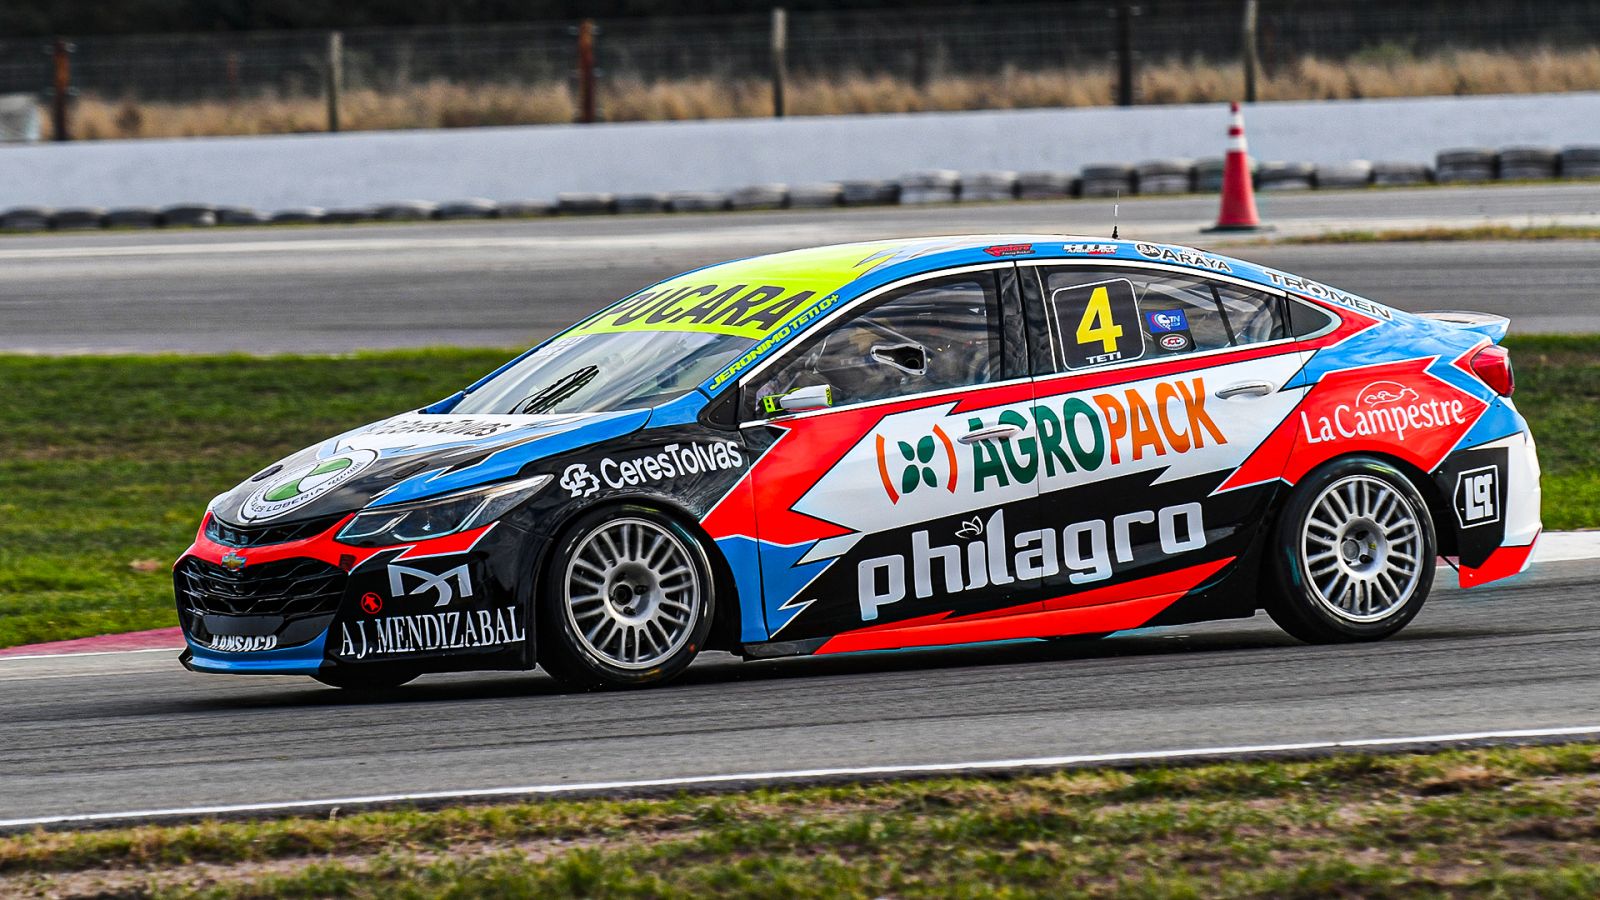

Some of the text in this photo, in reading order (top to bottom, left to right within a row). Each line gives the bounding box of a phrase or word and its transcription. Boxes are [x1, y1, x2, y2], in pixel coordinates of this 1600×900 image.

[1162, 249, 1232, 272] ARAYA
[579, 284, 817, 331] PUCARA
[1076, 286, 1123, 353] 4
[709, 326, 792, 391] JERONIMO
[788, 307, 821, 333] TETI
[1085, 351, 1122, 365] TETI
[968, 377, 1229, 493] AGROPACK
[1334, 399, 1467, 441] Campestre
[600, 441, 743, 489] CeresTolvas
[266, 487, 325, 513] LOBERIA
[858, 502, 1207, 622] philagro
[374, 605, 526, 654] MENDIZABAL
